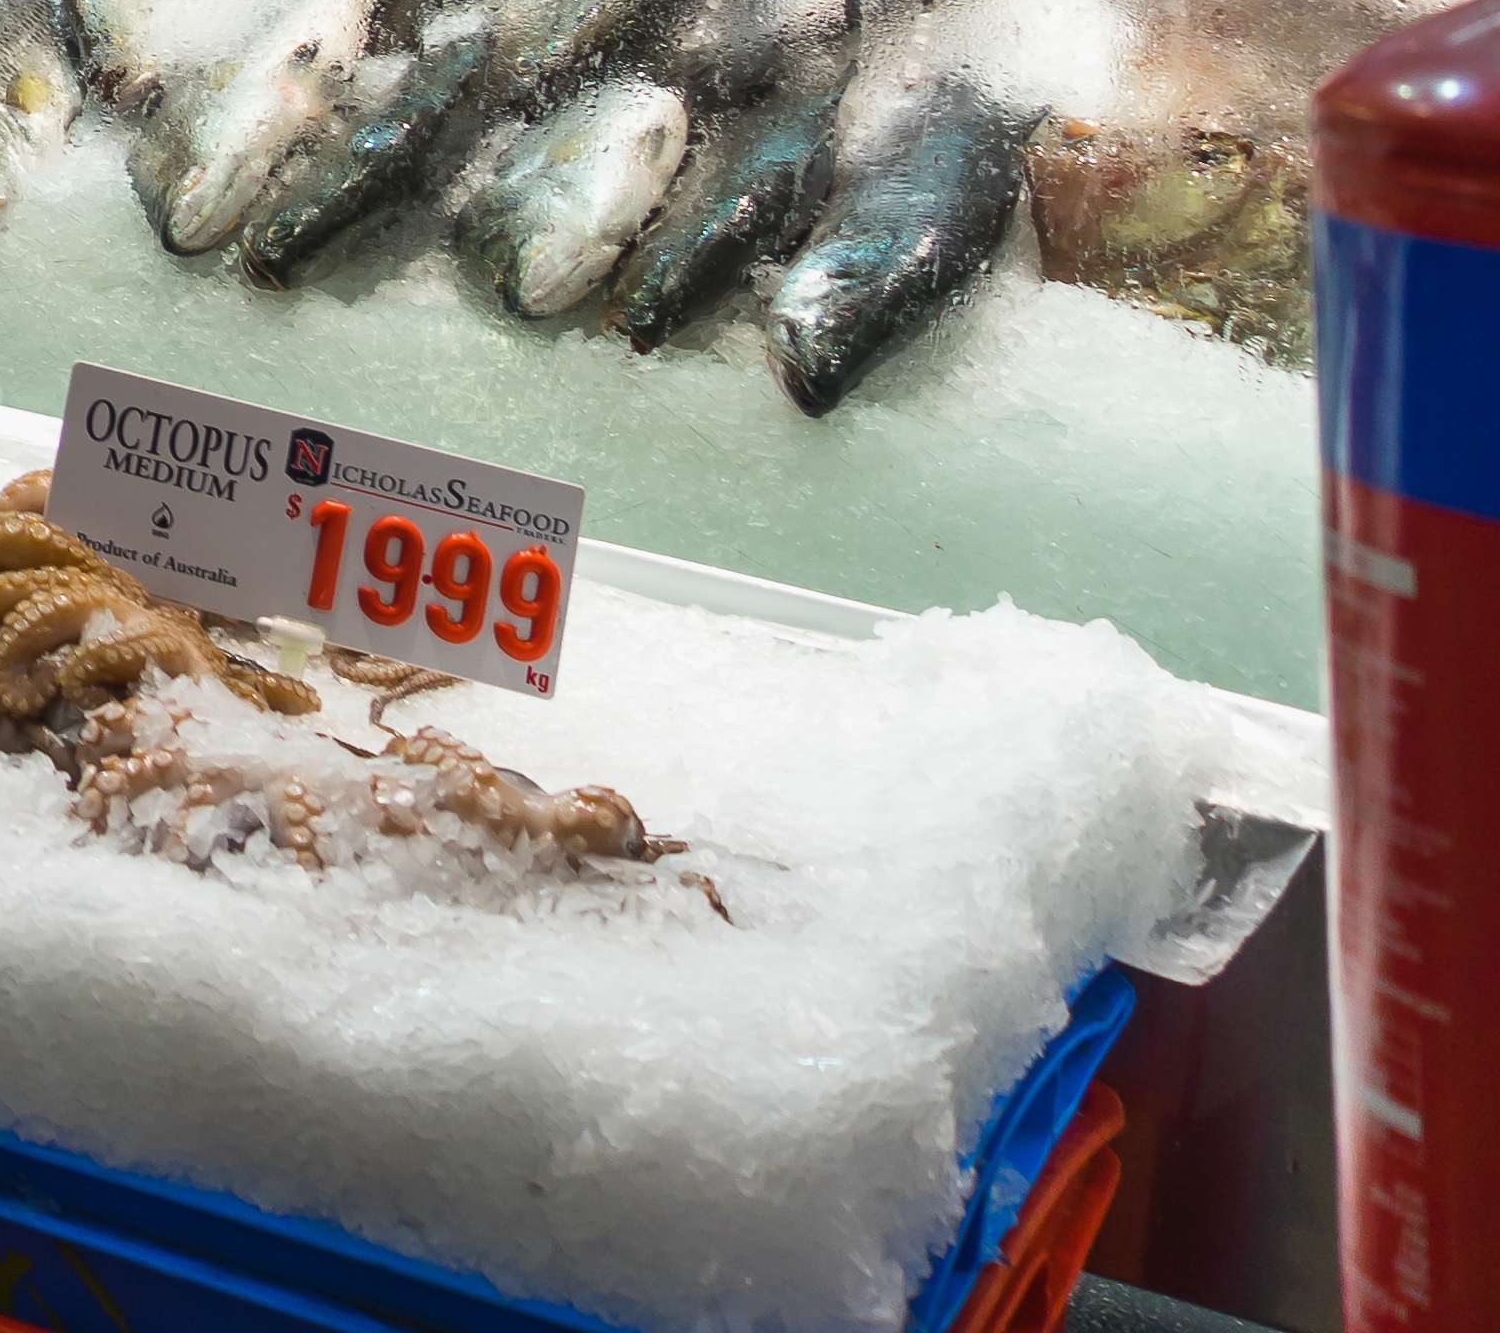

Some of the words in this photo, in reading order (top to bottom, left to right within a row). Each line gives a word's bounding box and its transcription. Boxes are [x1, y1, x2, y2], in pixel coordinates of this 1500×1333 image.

[85, 399, 271, 483] OCTOPUS
[103, 448, 238, 503] MEDIUM
[77, 532, 126, 563] Product
[142, 550, 162, 569] of
[163, 555, 238, 588] Australia
[525, 665, 550, 693] kg
